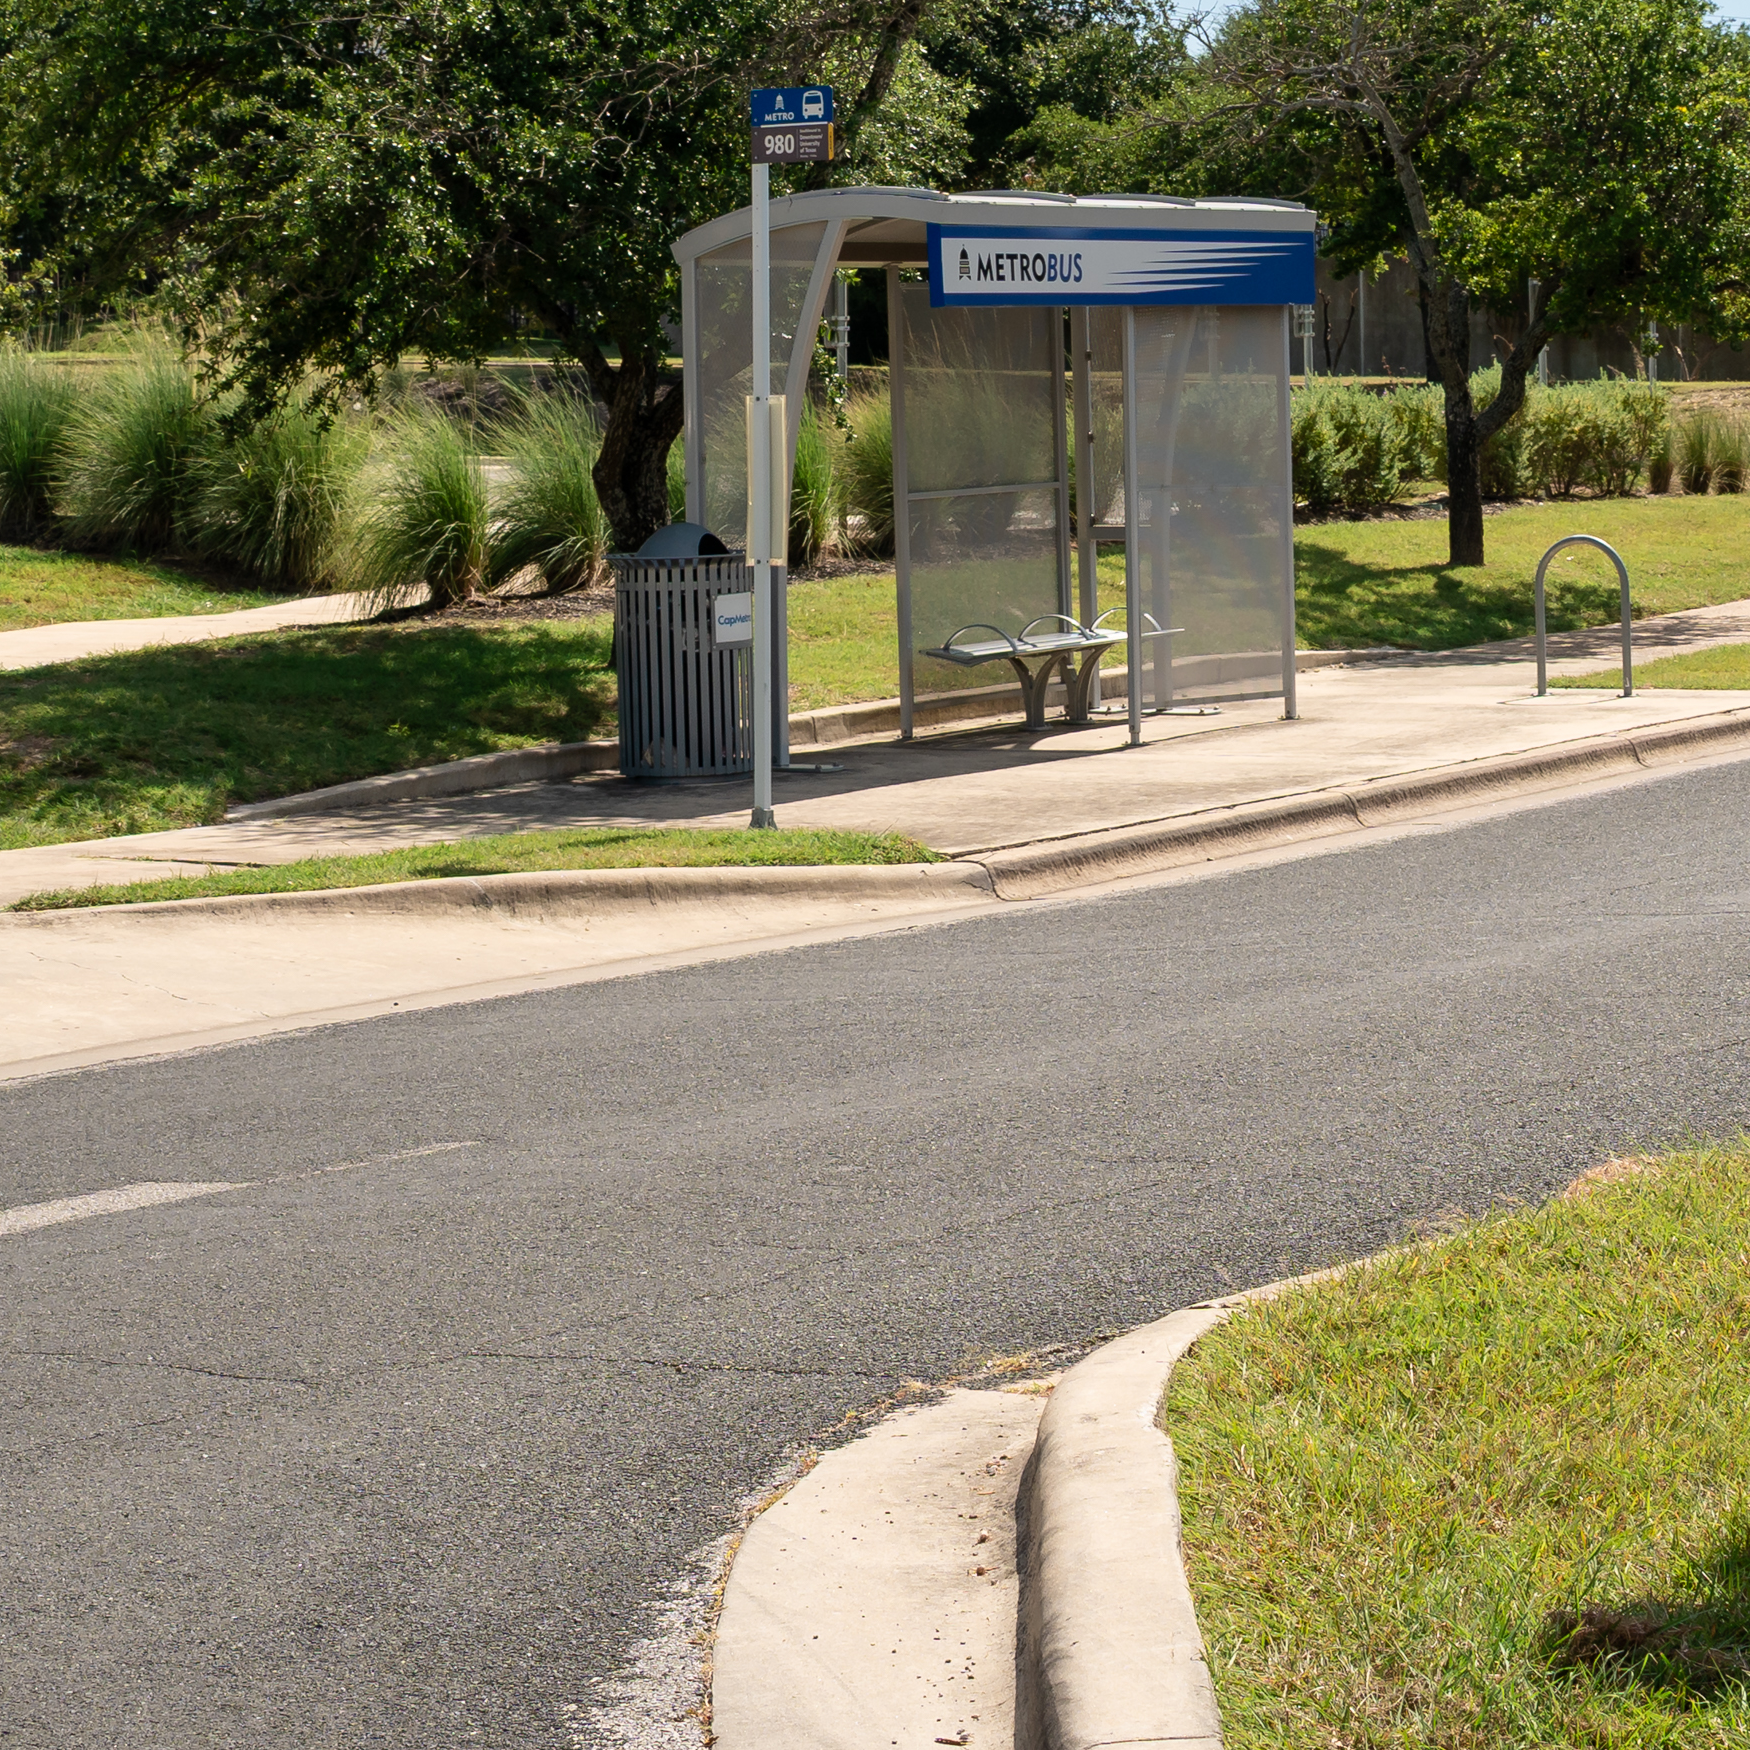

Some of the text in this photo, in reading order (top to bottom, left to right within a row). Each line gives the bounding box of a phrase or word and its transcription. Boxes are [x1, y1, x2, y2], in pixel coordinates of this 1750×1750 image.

[764, 112, 795, 121] METRO
[764, 134, 795, 155] 980
[977, 252, 1083, 283] METROBUS
